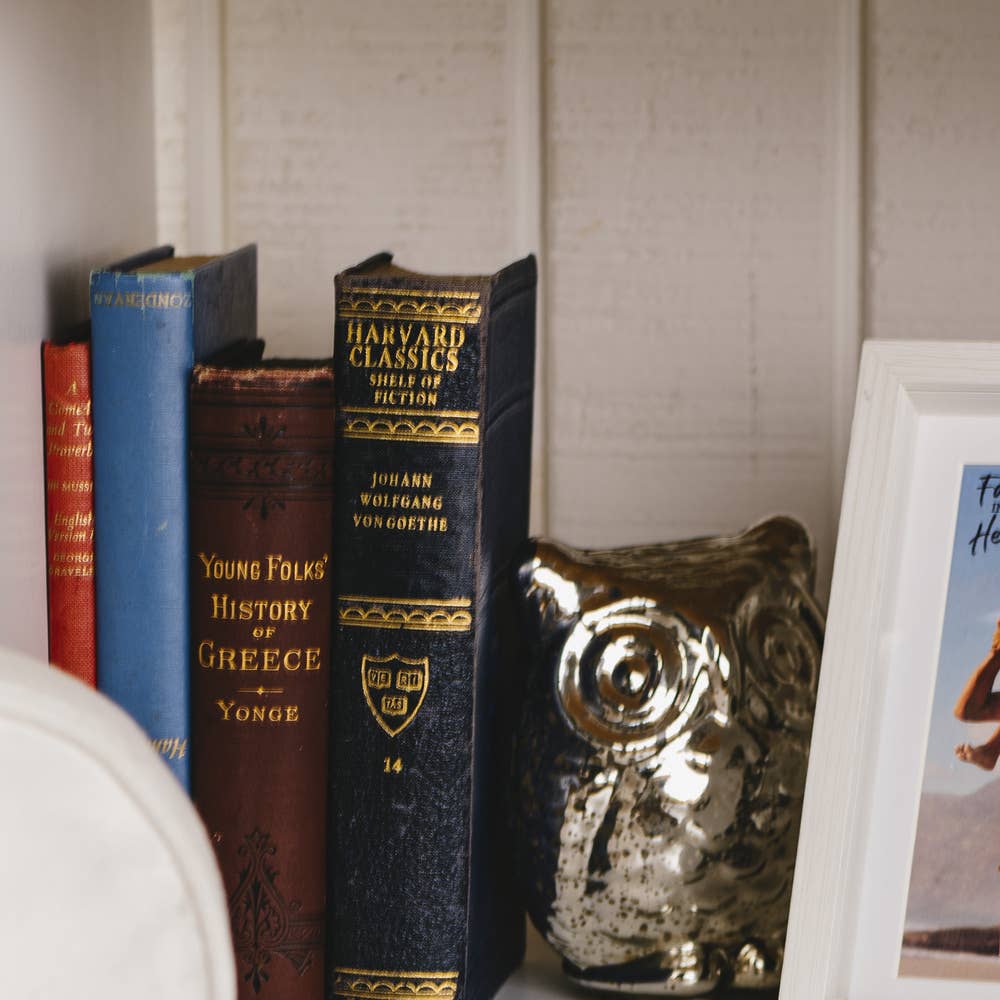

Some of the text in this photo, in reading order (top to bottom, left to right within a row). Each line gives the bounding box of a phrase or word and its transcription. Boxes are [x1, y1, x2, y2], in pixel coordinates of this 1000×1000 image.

[346, 320, 466, 348] HARVARD
[349, 345, 460, 372] CLASSICS
[66, 381, 80, 397] A
[369, 373, 442, 390] SHELF OF
[374, 391, 438, 406] FICTION
[371, 472, 433, 488] JOHANN
[360, 492, 443, 511] WOLFGANG
[353, 513, 449, 532] VON GOETHE
[198, 640, 321, 672] GREECE
[216, 700, 299, 722] YONGE
[384, 757, 404, 774] 14
